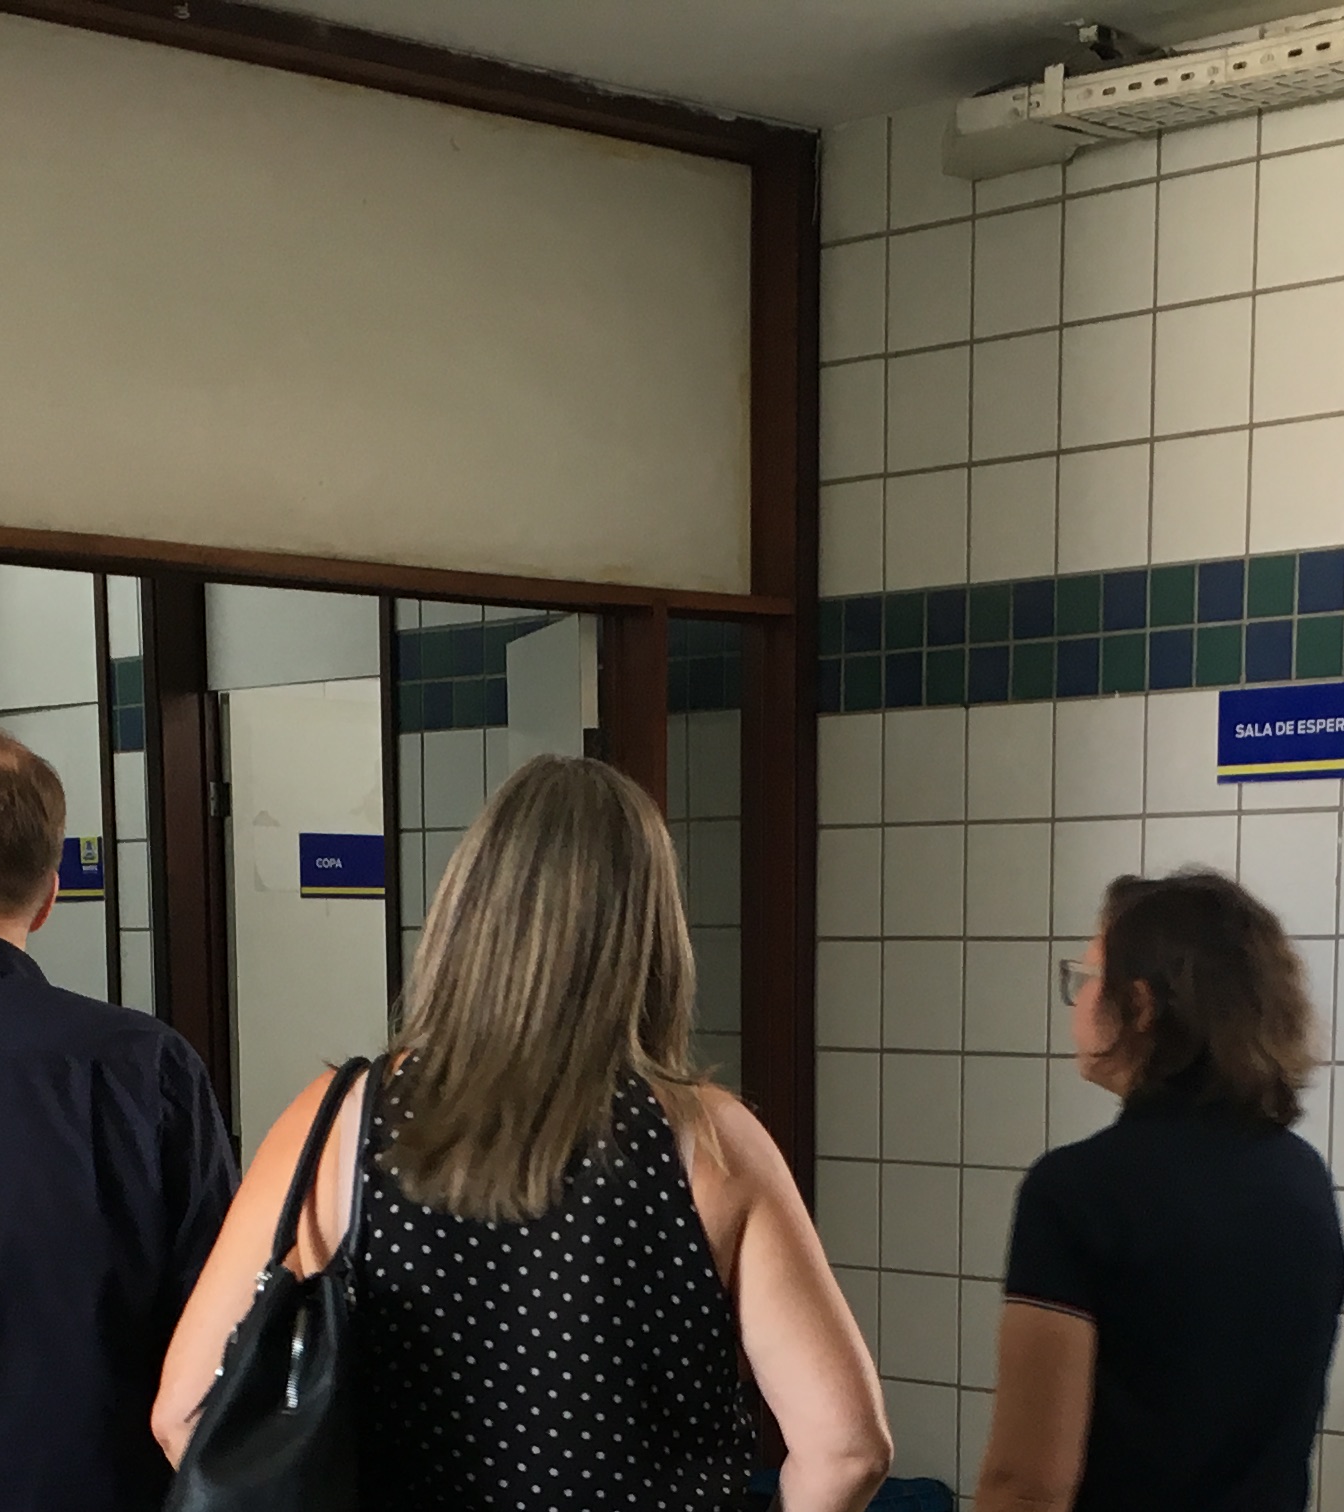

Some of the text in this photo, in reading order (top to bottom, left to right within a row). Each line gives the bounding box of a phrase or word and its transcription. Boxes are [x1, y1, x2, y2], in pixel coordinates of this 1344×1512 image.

[1235, 723, 1273, 739] SALA
[1275, 720, 1295, 736] DE
[316, 857, 343, 868] COPA
